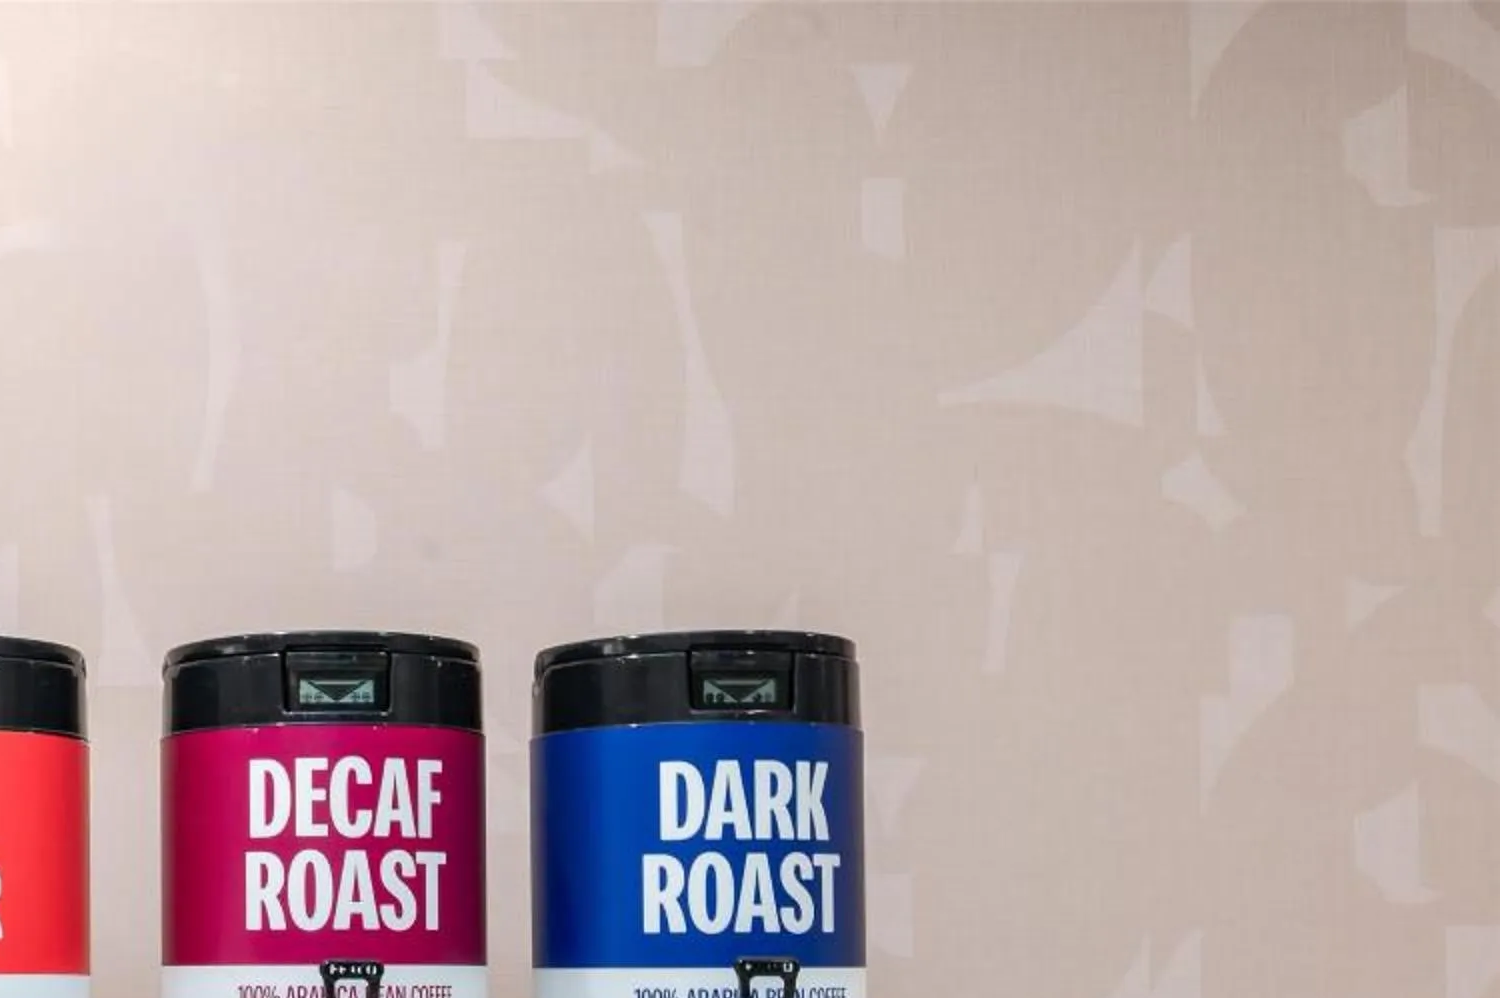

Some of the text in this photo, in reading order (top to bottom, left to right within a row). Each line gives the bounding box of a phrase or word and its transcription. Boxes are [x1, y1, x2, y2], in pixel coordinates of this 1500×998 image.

[249, 755, 443, 839] DECAF
[659, 759, 830, 841] DARK
[245, 849, 447, 931] ROAST
[642, 851, 841, 935] ROAST
